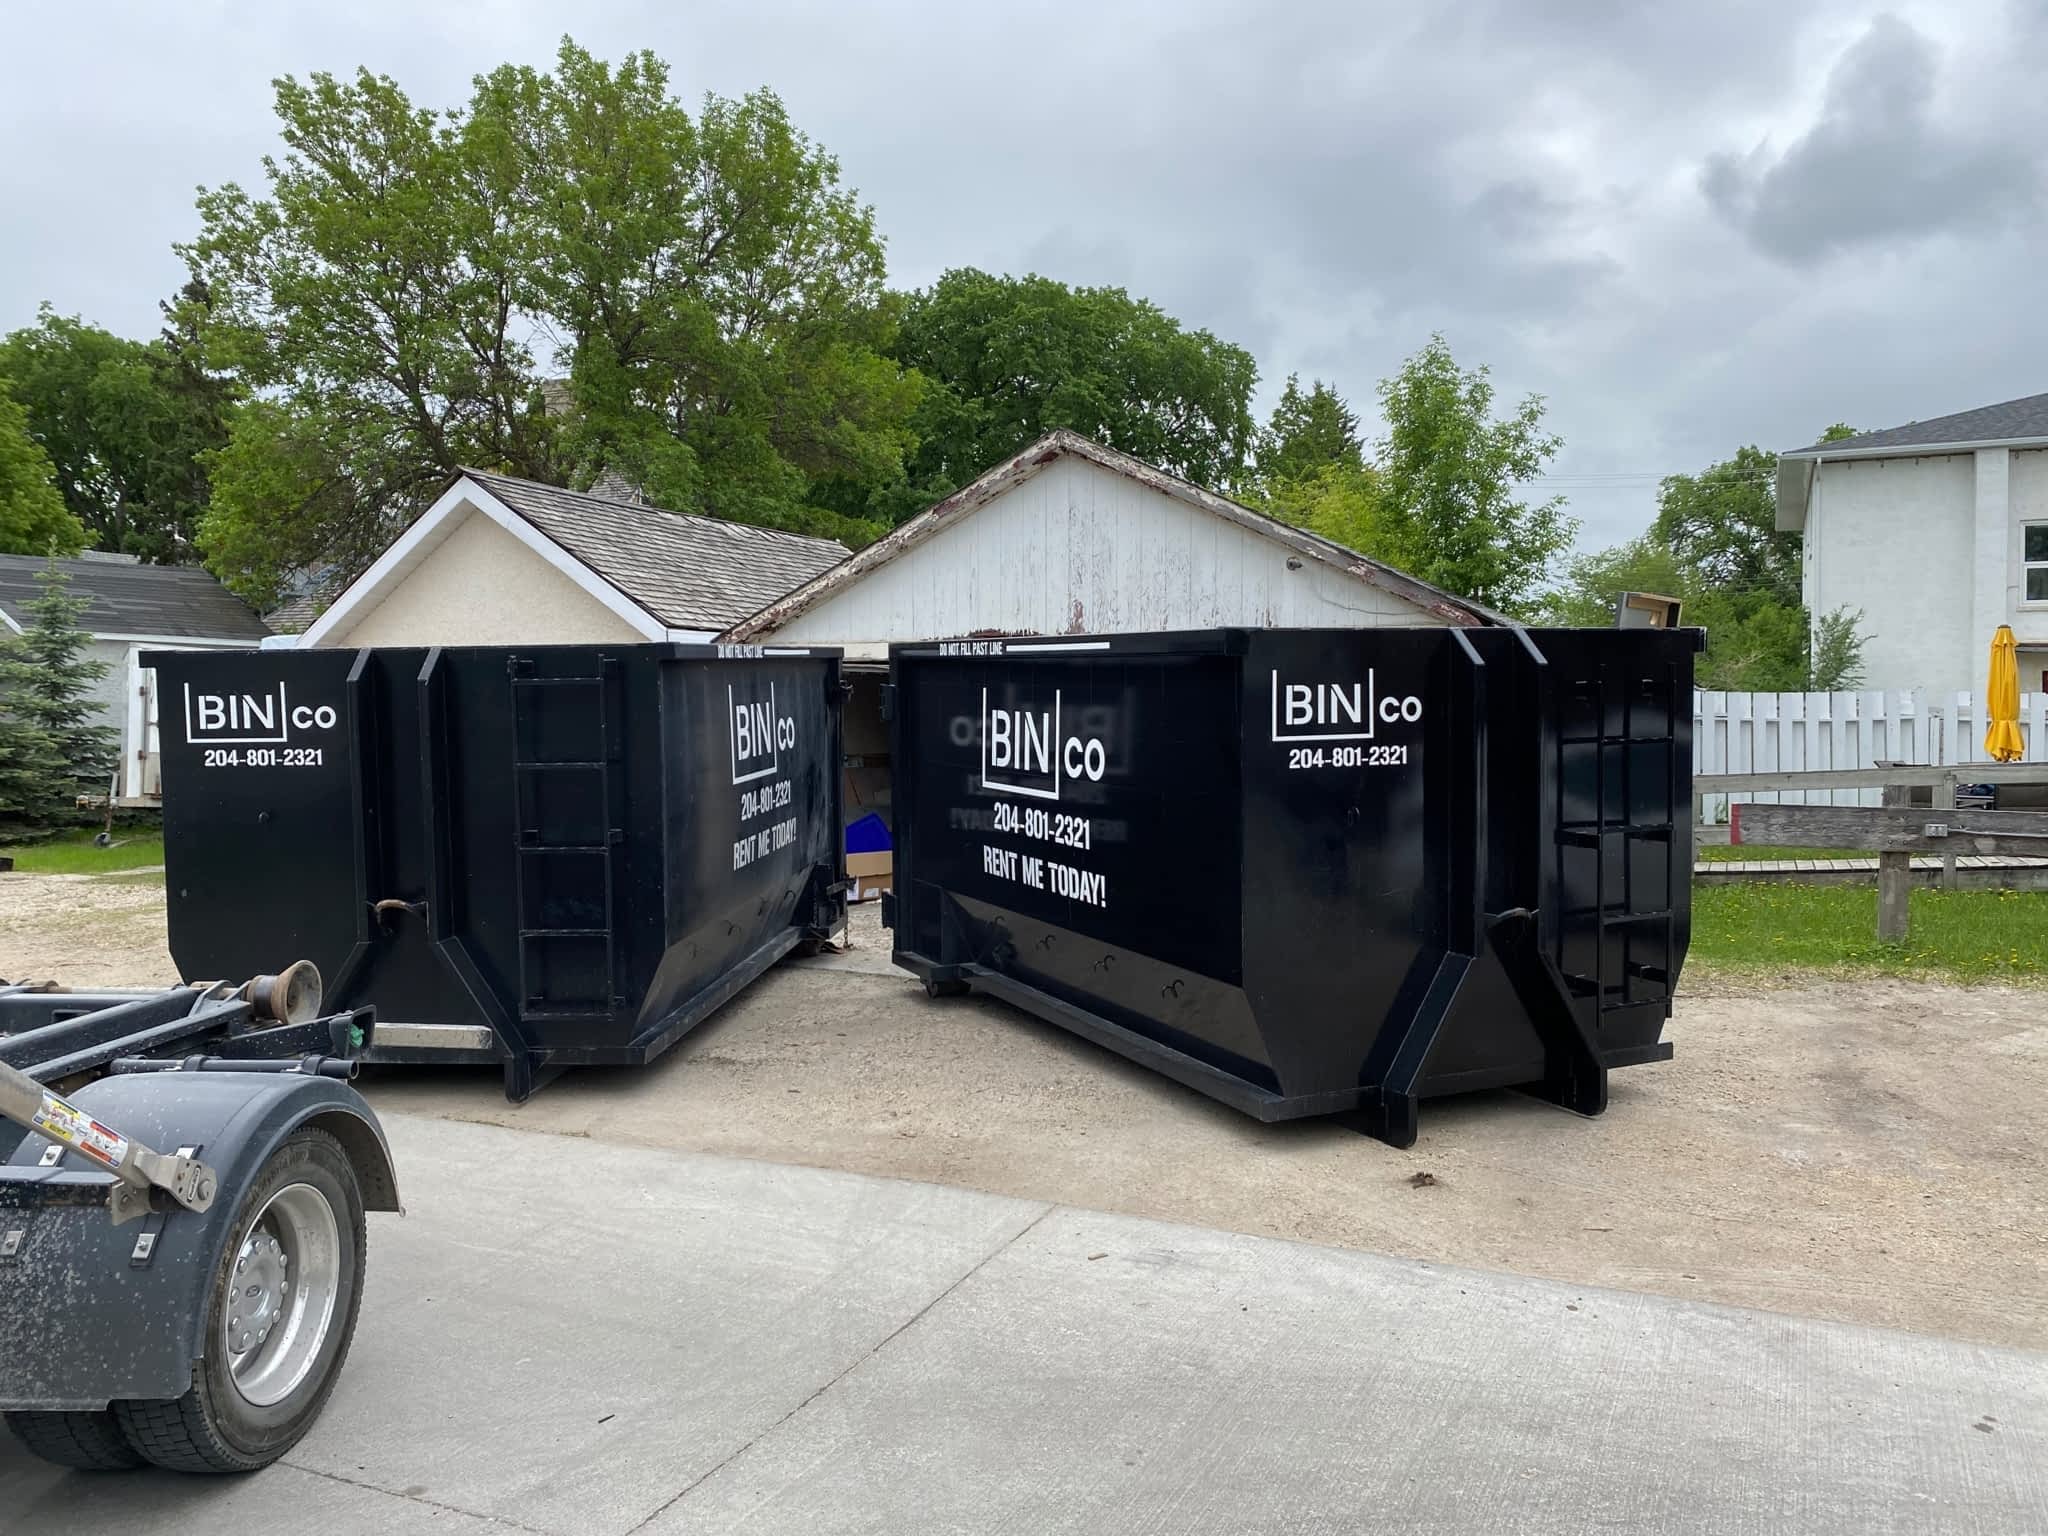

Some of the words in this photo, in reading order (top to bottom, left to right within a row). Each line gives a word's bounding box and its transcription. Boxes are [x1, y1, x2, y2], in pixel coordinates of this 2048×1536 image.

[718, 645, 725, 658] DO
[725, 645, 734, 658] NOT
[743, 645, 754, 658] PAST
[939, 643, 948, 656] DO
[948, 643, 960, 656] NOT
[960, 642, 972, 655] FILL
[972, 642, 988, 656] PAST
[989, 641, 1003, 655] LINE
[198, 694, 275, 730] BIN
[1285, 683, 1362, 726] BIN
[735, 701, 772, 761] BIN
[991, 709, 1050, 774] BIN
[204, 748, 323, 768] 204-801-2321
[1288, 745, 1408, 769] 204-801-2321
[741, 779, 791, 821] 204-801-2321
[733, 833, 757, 871] RENT
[757, 828, 770, 859] ME
[771, 816, 797, 852] TODAY!
[993, 801, 1091, 850] 204-801-2321
[983, 844, 1018, 881] RENT
[1022, 855, 1044, 890] ME
[1047, 861, 1107, 908] TODAY!
